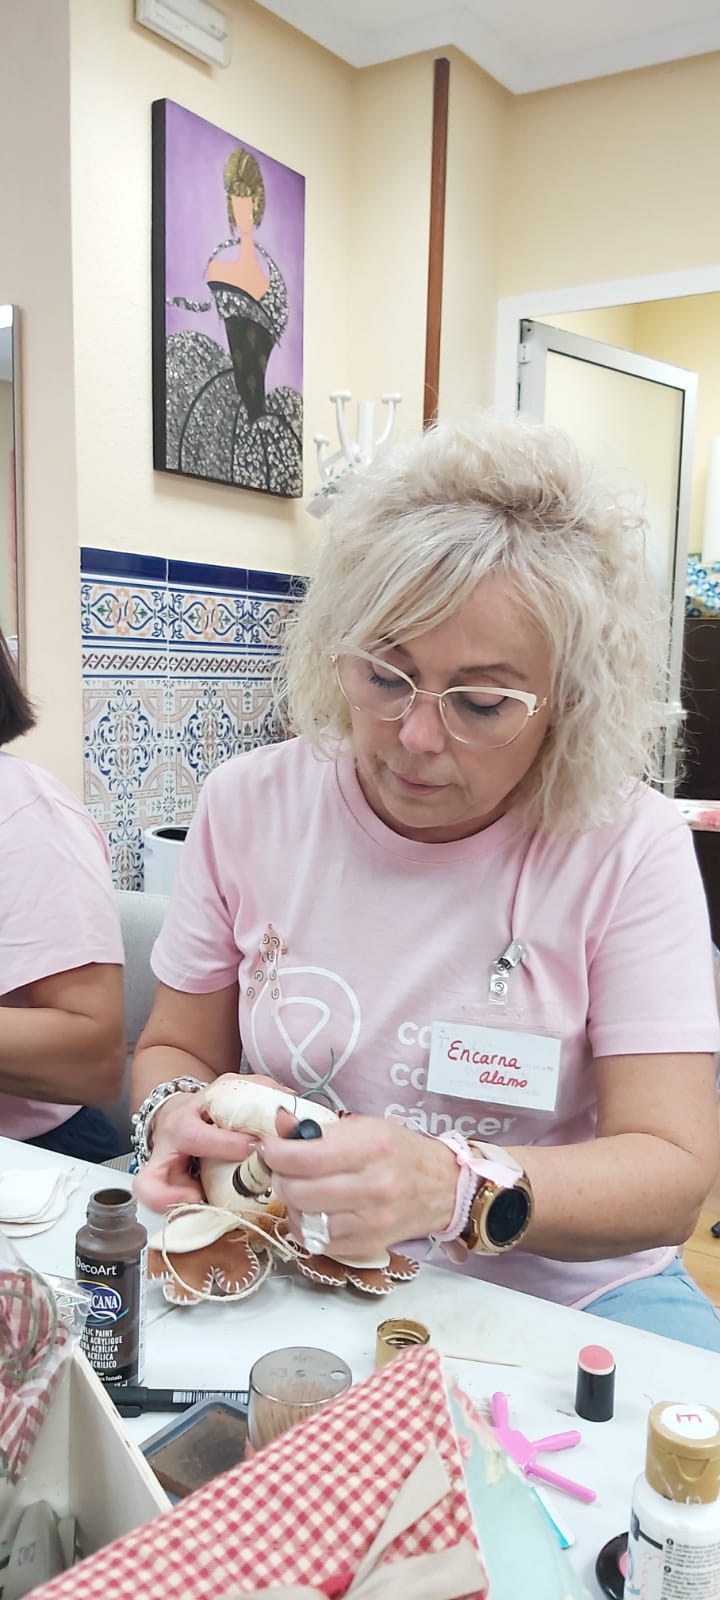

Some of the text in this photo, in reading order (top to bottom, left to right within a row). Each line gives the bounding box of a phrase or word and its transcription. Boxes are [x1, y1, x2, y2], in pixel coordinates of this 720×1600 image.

[397, 1022, 432, 1049] co
[447, 1040, 521, 1069] Encarna
[390, 1063, 427, 1090] co
[384, 1100, 517, 1136] cáncer
[76, 1256, 117, 1276] DecoArt
[92, 1295, 118, 1309] CANA
[90, 1336, 123, 1345] ACRYLIQUE
[95, 1329, 113, 1337] PAINT
